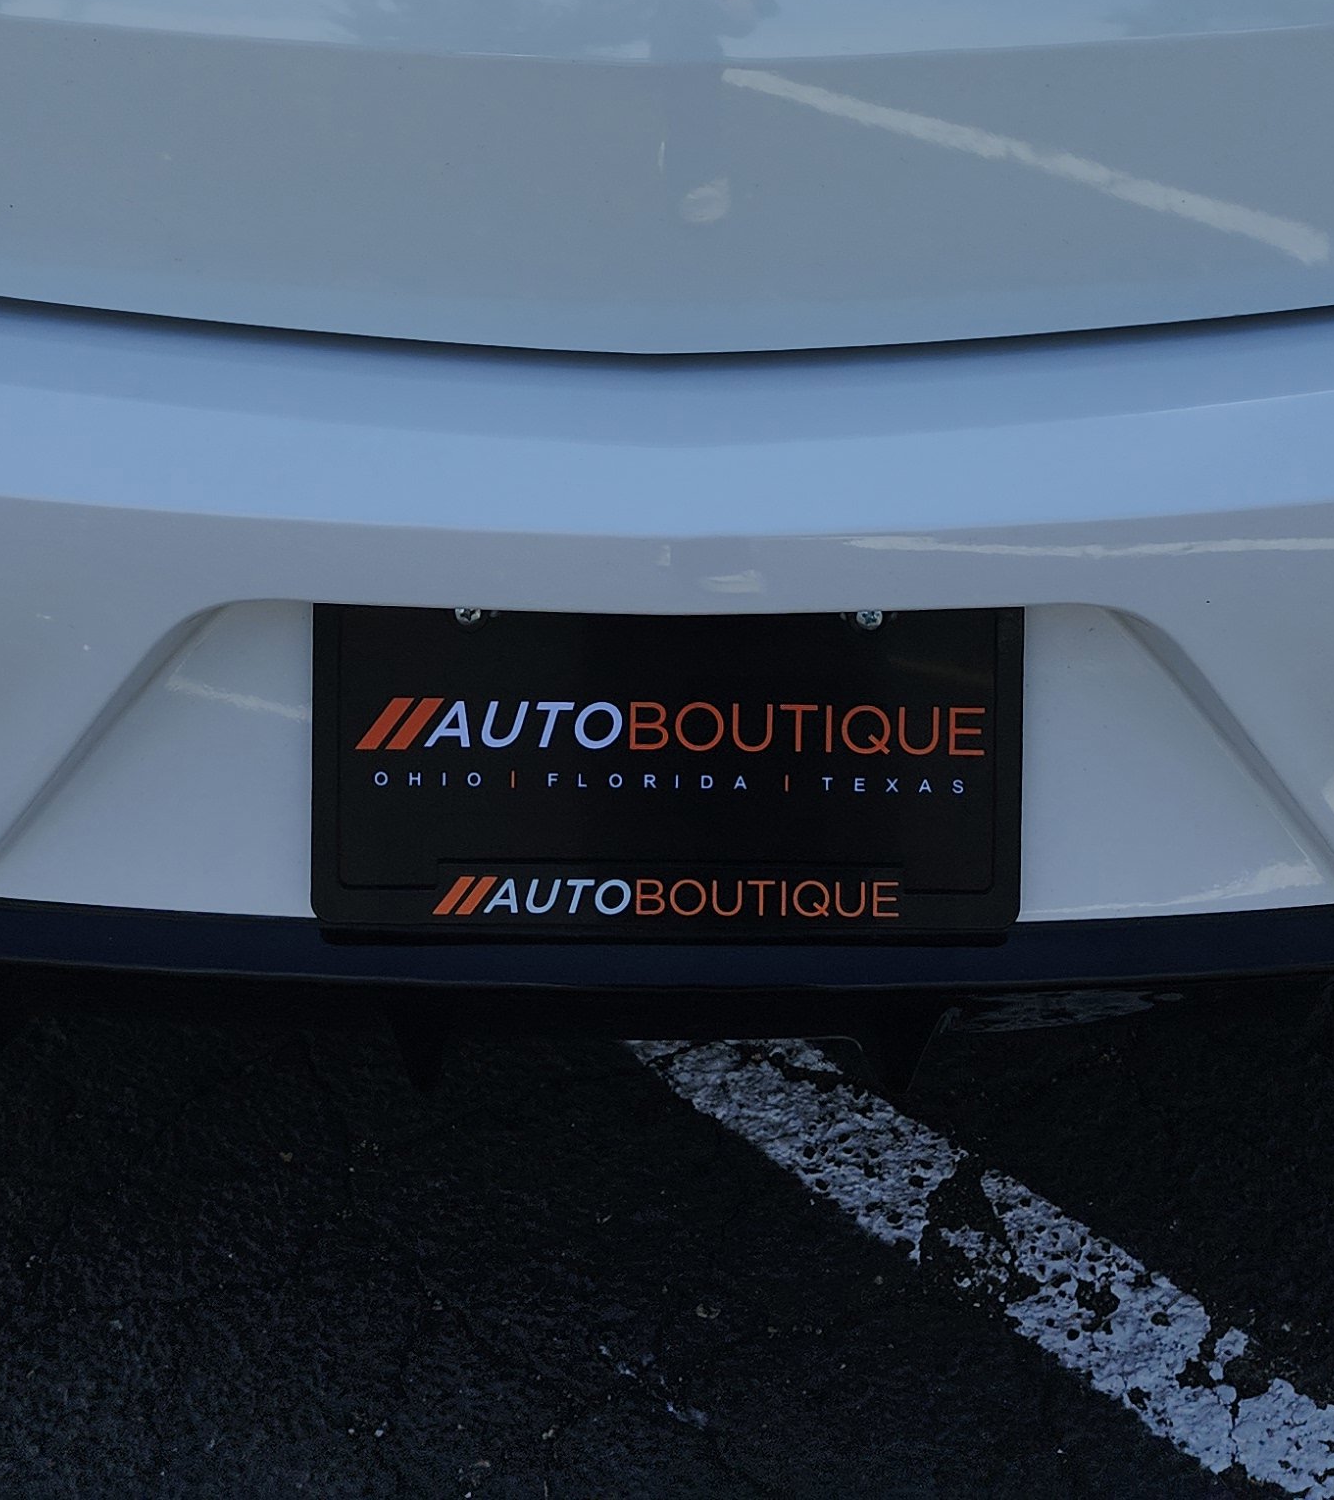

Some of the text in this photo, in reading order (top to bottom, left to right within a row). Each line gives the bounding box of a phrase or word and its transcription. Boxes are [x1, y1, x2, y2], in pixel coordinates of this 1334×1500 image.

[424, 700, 986, 757] AUTOBOUTIQUE
[374, 771, 966, 795] OHIO FLORIDA TEXAS
[482, 878, 901, 919] AUTOBOUTIQUE
